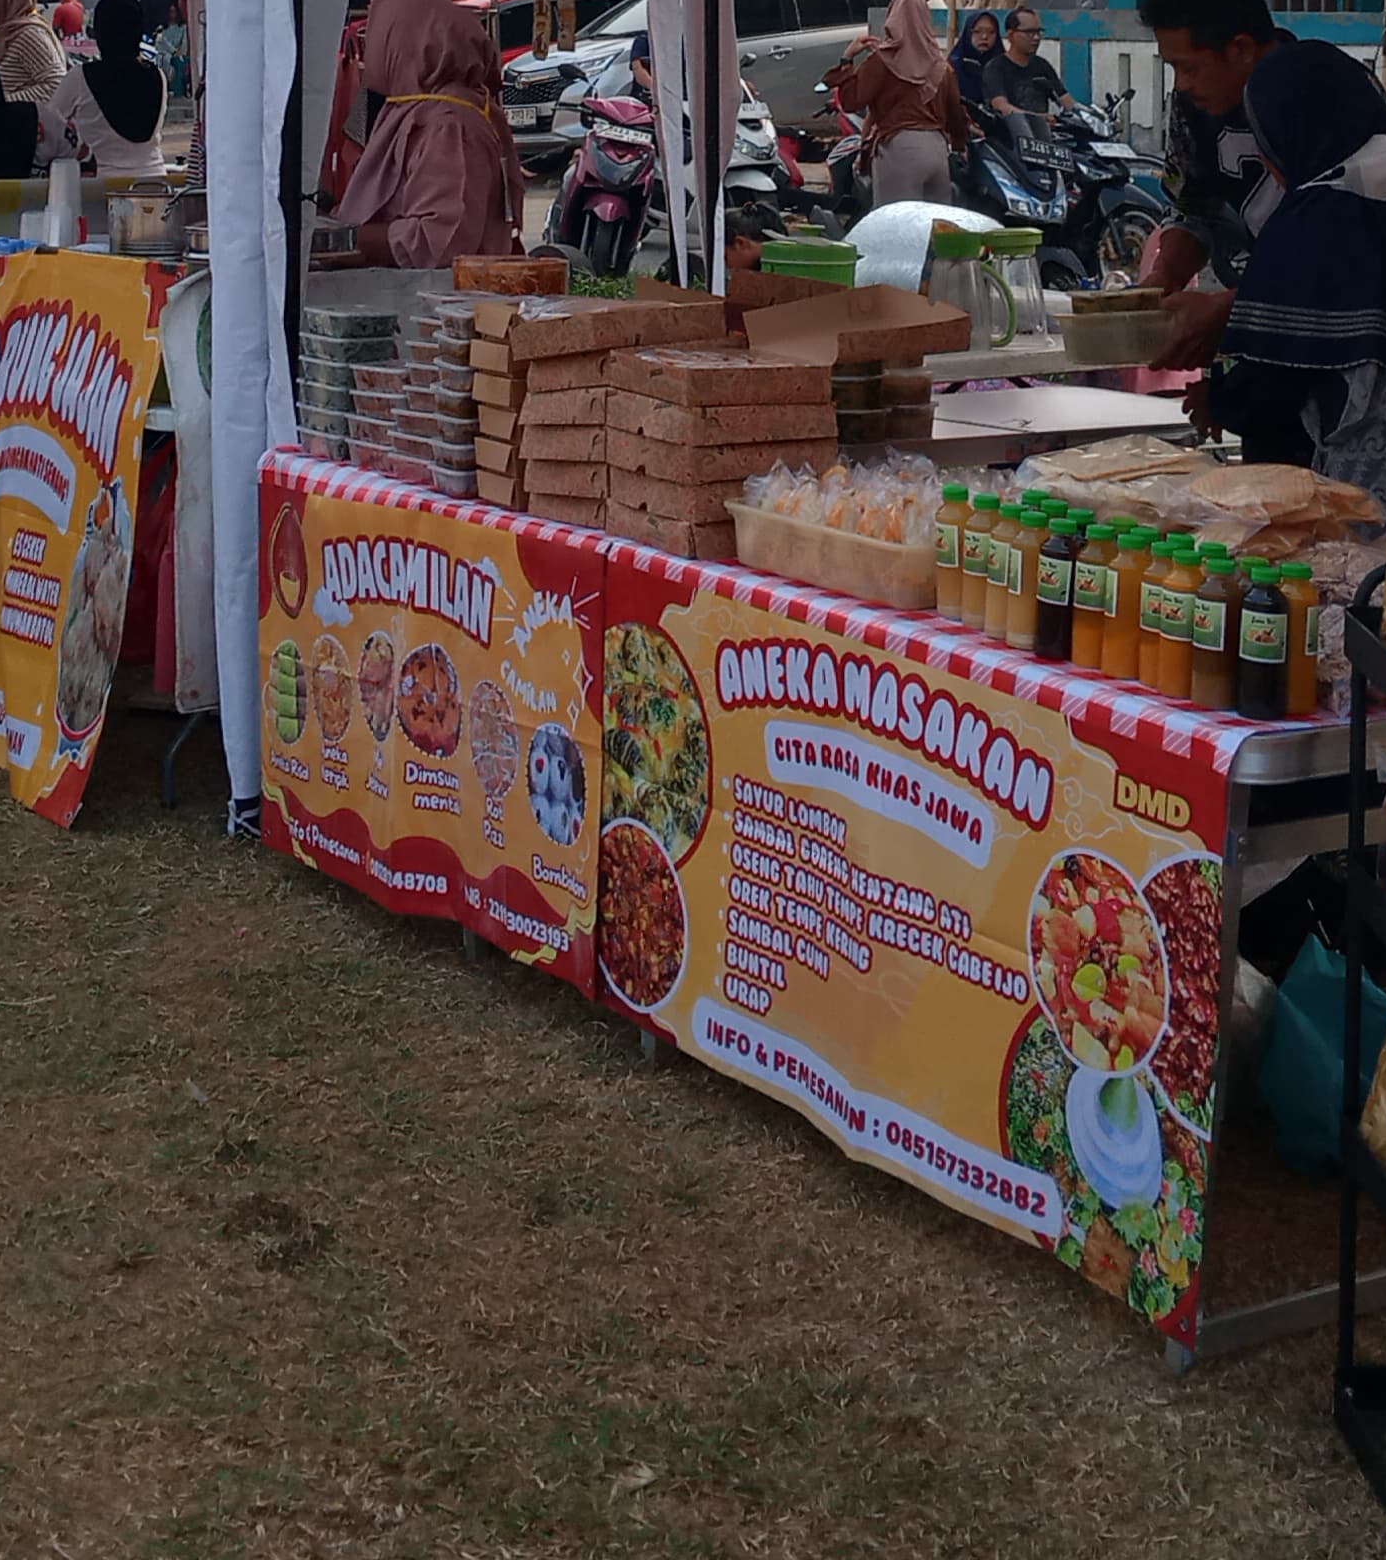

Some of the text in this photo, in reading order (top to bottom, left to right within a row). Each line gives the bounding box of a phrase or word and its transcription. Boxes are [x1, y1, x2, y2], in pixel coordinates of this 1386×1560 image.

[513, 590, 574, 657] ANEKA
[719, 642, 1053, 826] ANEKA MASAKAN
[734, 776, 846, 847] SAYUR LOMBOK
[774, 737, 983, 846] CITA RASA KHAS JAWA
[1116, 774, 1191, 829] DMD
[734, 810, 796, 855] SAMBAL
[729, 874, 872, 973] OREK TEMPE KERING
[731, 843, 781, 883] OSENG
[783, 863, 825, 905] TAHU
[826, 885, 864, 933] TEMPE
[868, 910, 946, 965] KRECEK
[725, 940, 787, 990] BUNTIL
[727, 906, 830, 981] SAMBAL CUMI
[724, 973, 771, 1016] URAP
[706, 1017, 751, 1056] INFO
[755, 1042, 768, 1067] &
